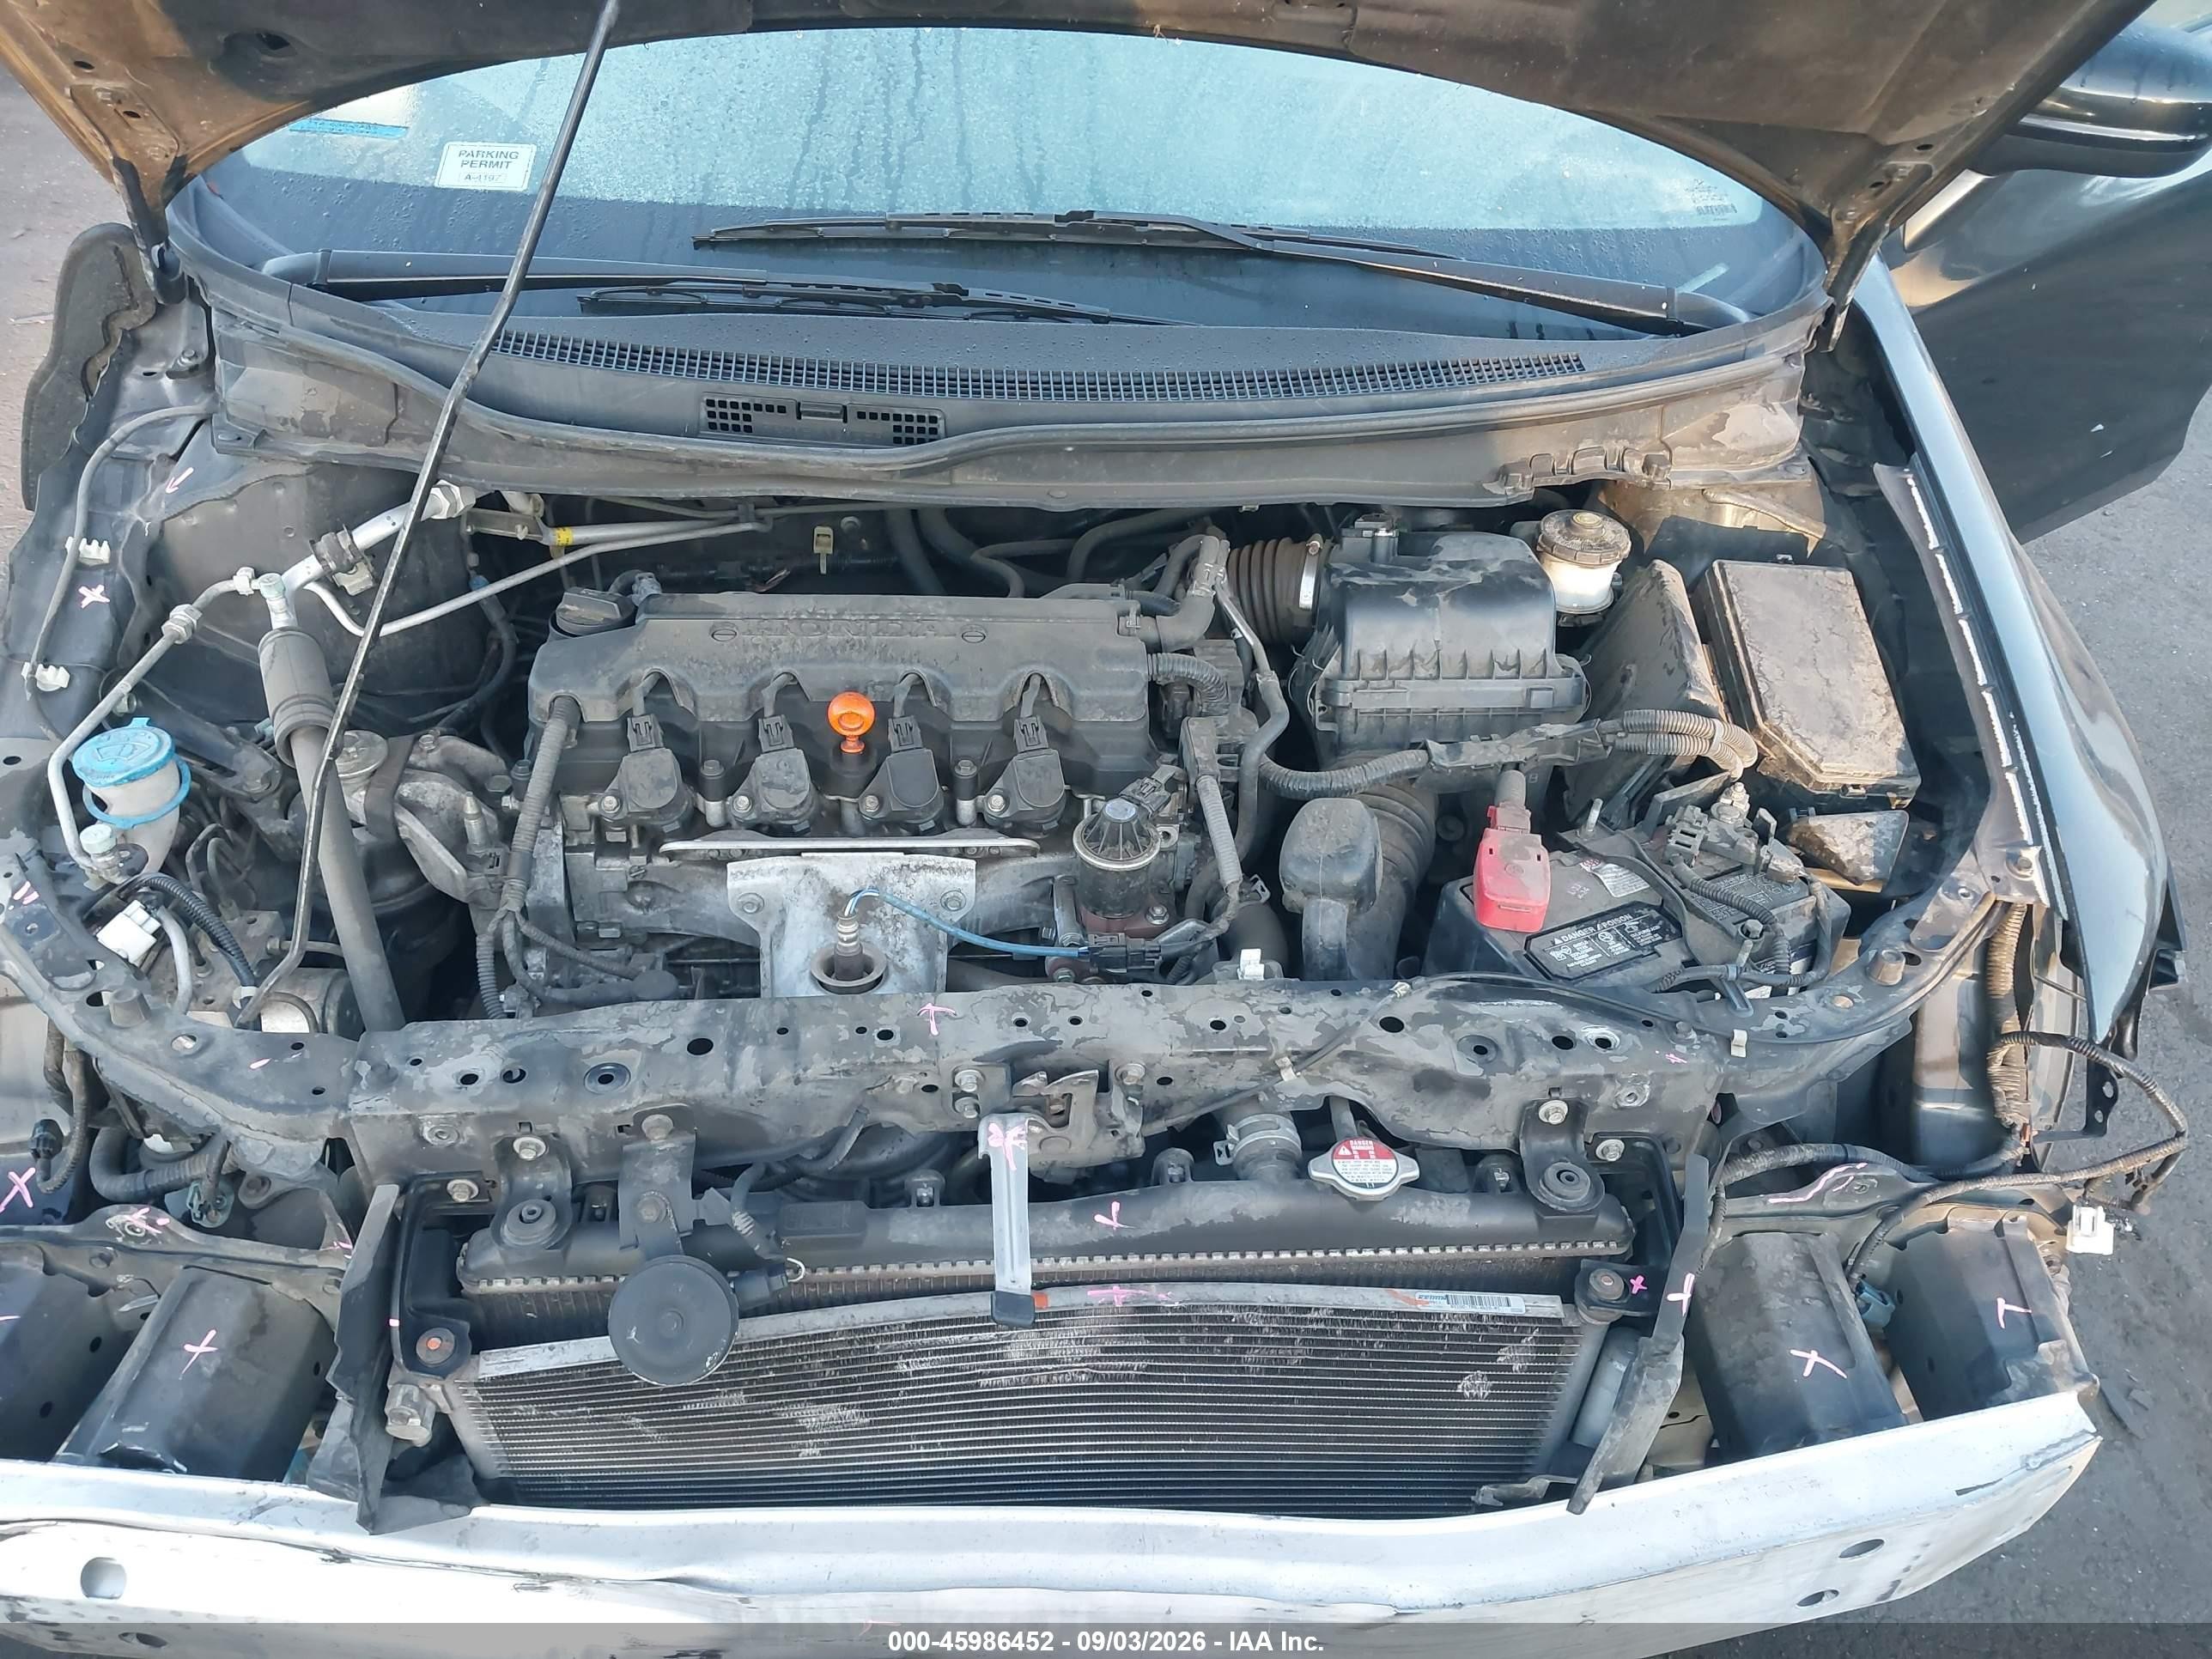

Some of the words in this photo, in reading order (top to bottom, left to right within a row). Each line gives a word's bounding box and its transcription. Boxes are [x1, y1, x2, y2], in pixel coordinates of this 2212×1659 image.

[459, 150, 520, 160] PARKING
[460, 161, 513, 169] PERMIT
[1561, 927, 1596, 943] DANGER
